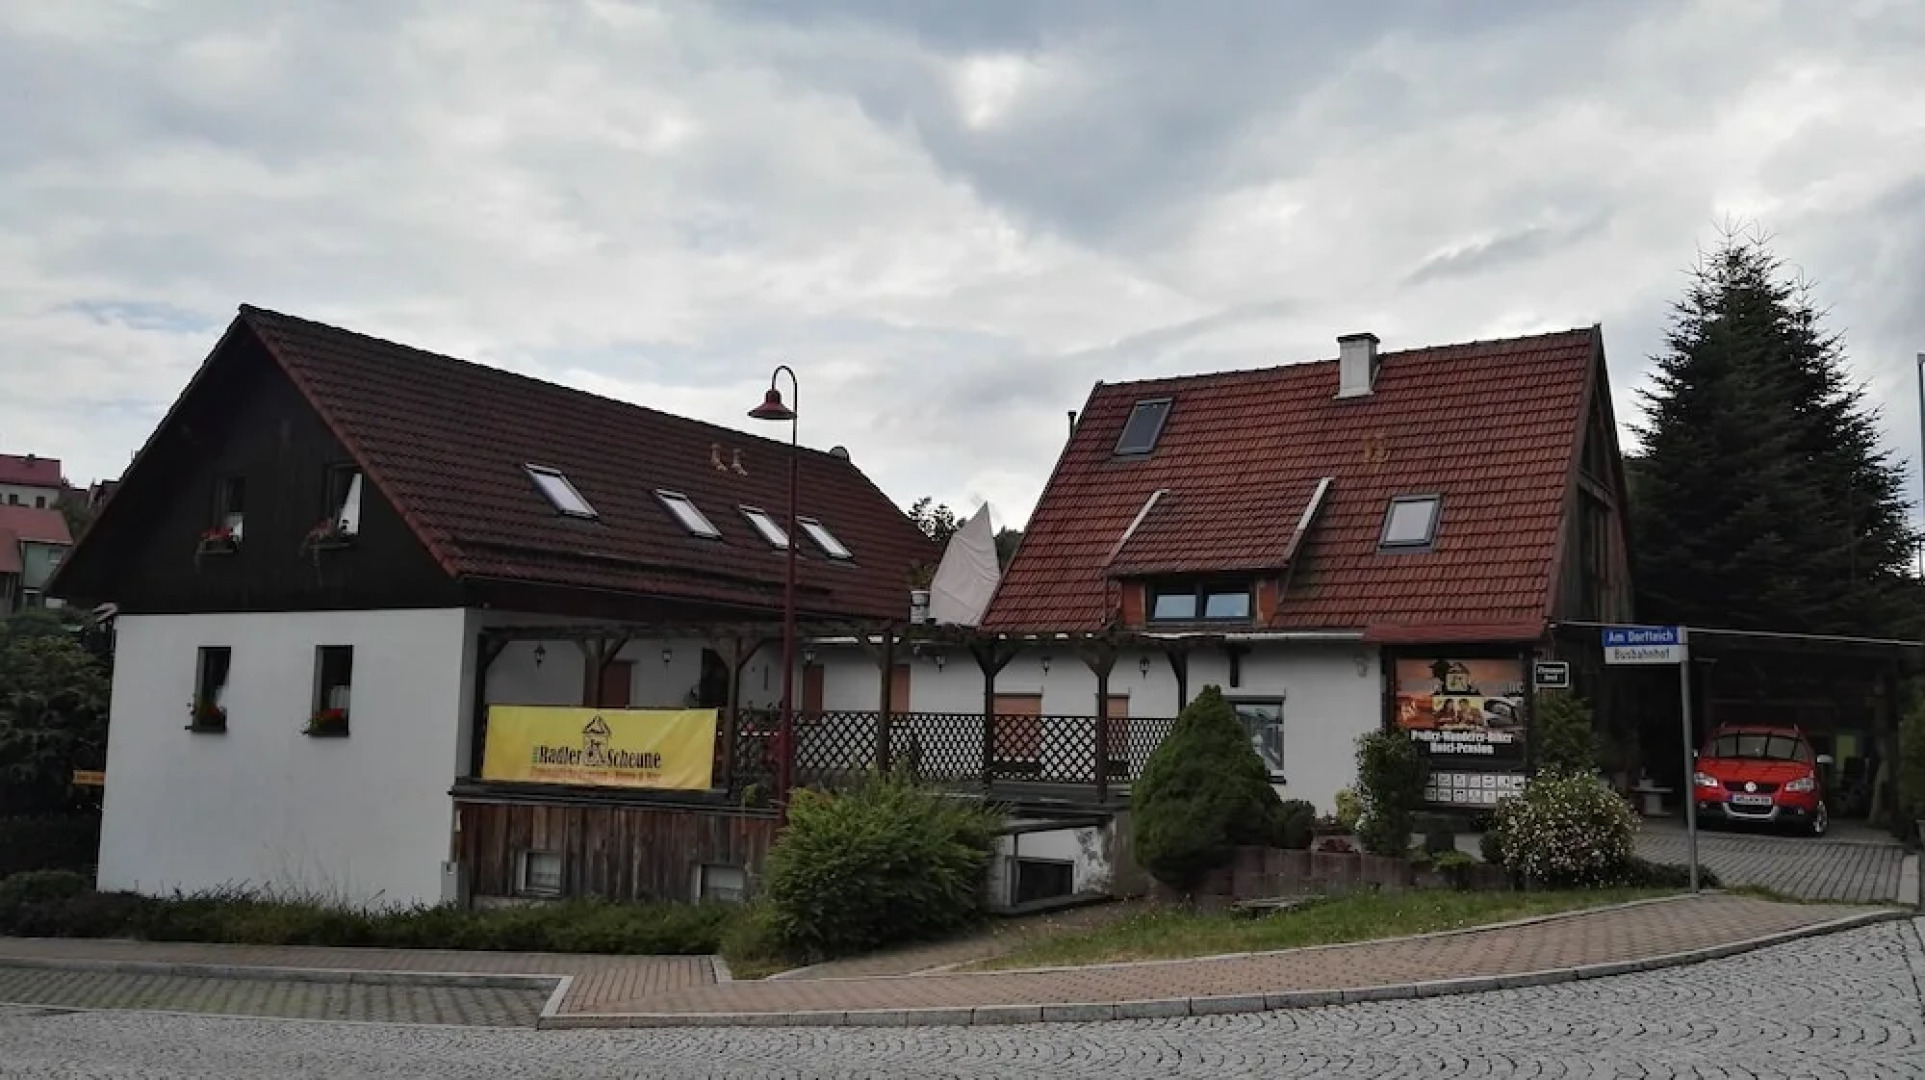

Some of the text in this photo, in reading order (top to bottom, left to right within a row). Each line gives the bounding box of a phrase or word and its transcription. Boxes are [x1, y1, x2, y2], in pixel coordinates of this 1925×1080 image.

[1608, 629, 1673, 642] Am Dorfteich
[1614, 646, 1670, 660] Busbahnhof
[539, 746, 582, 765] Radler
[607, 749, 661, 768] Scheune
